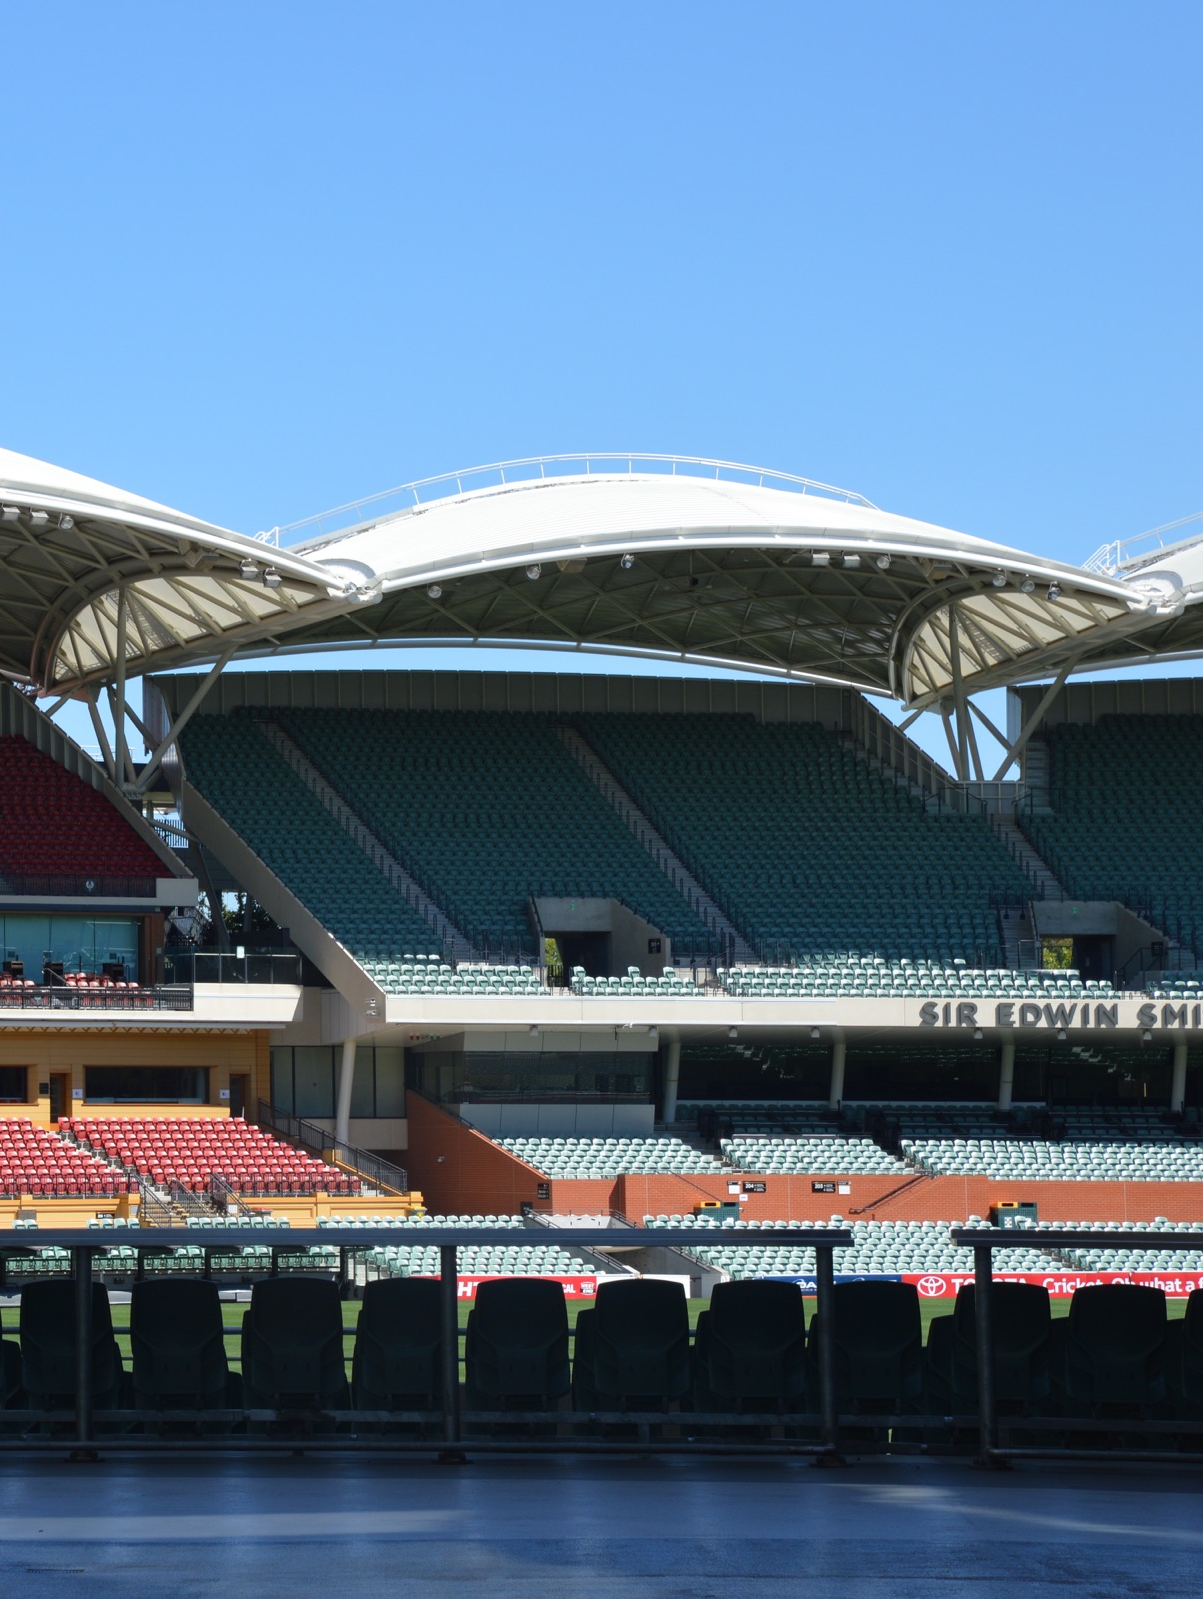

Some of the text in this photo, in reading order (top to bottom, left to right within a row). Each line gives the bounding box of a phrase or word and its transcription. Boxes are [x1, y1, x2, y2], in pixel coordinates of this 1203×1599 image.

[919, 1001, 1202, 1028] SIR EDWIN SMI
